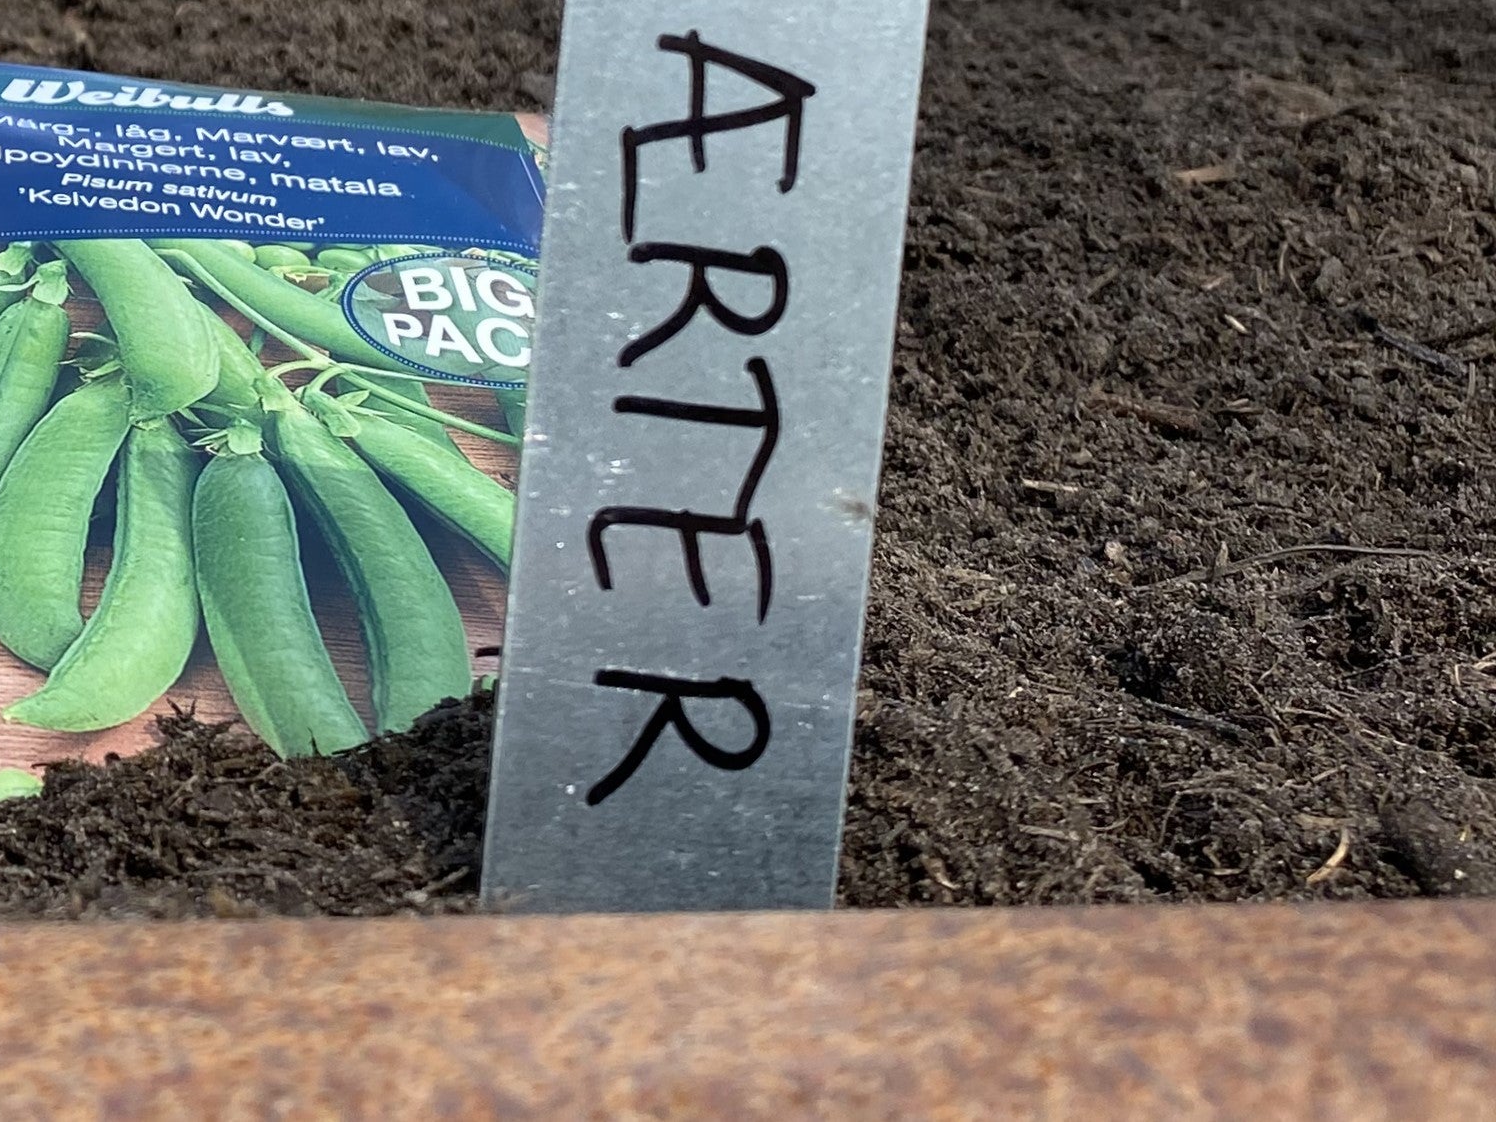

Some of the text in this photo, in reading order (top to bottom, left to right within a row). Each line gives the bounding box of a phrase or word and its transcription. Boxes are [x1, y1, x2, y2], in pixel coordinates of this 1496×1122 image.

[1, 78, 294, 116] Weibulls
[228, 145, 292, 169] lav,
[376, 140, 439, 162] lav,
[61, 172, 277, 208] Pisum sativum
[270, 172, 402, 197] matala
[399, 266, 537, 319] BIG
[382, 312, 532, 368] PAC
